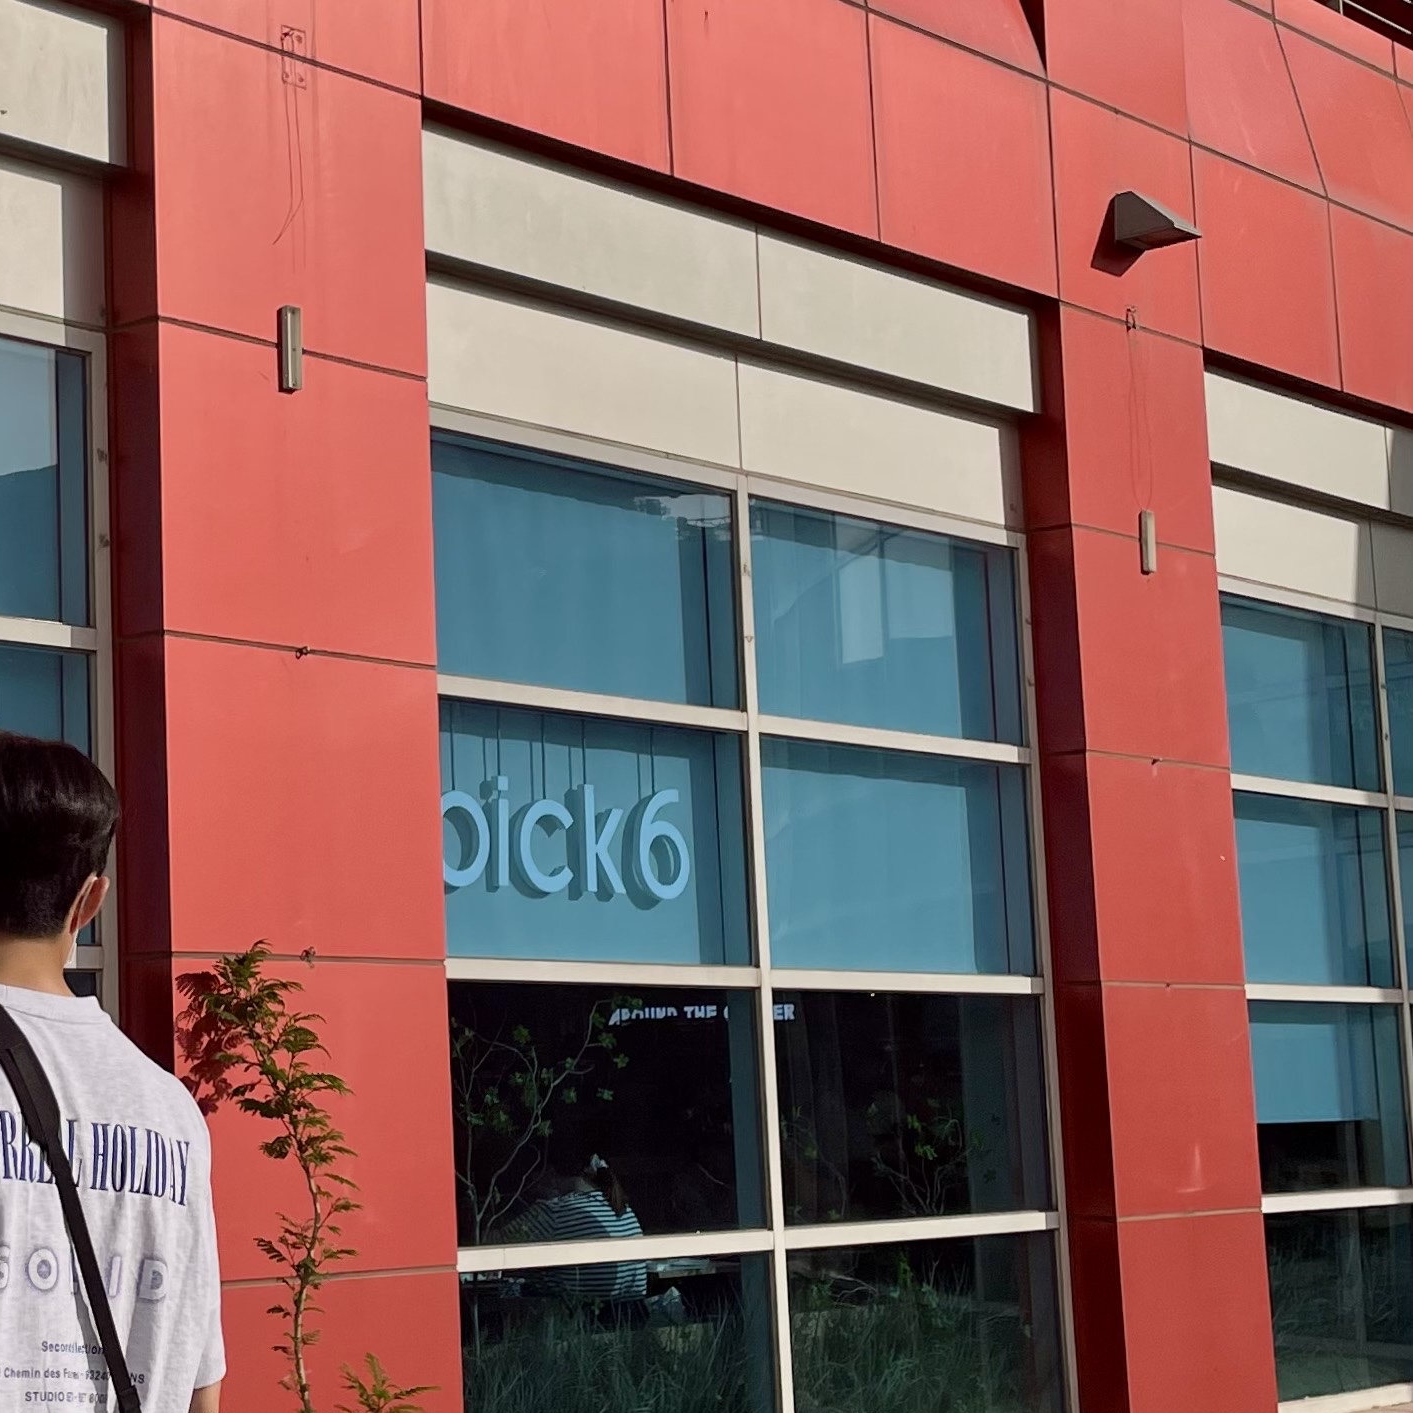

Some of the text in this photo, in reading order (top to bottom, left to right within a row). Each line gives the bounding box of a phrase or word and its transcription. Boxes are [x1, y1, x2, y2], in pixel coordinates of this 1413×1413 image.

[89, 1120, 190, 1207] HOLIDAY
[4, 1366, 40, 1378] Chemin
[43, 1367, 61, 1379] des
[24, 1391, 65, 1402] STUDIO
